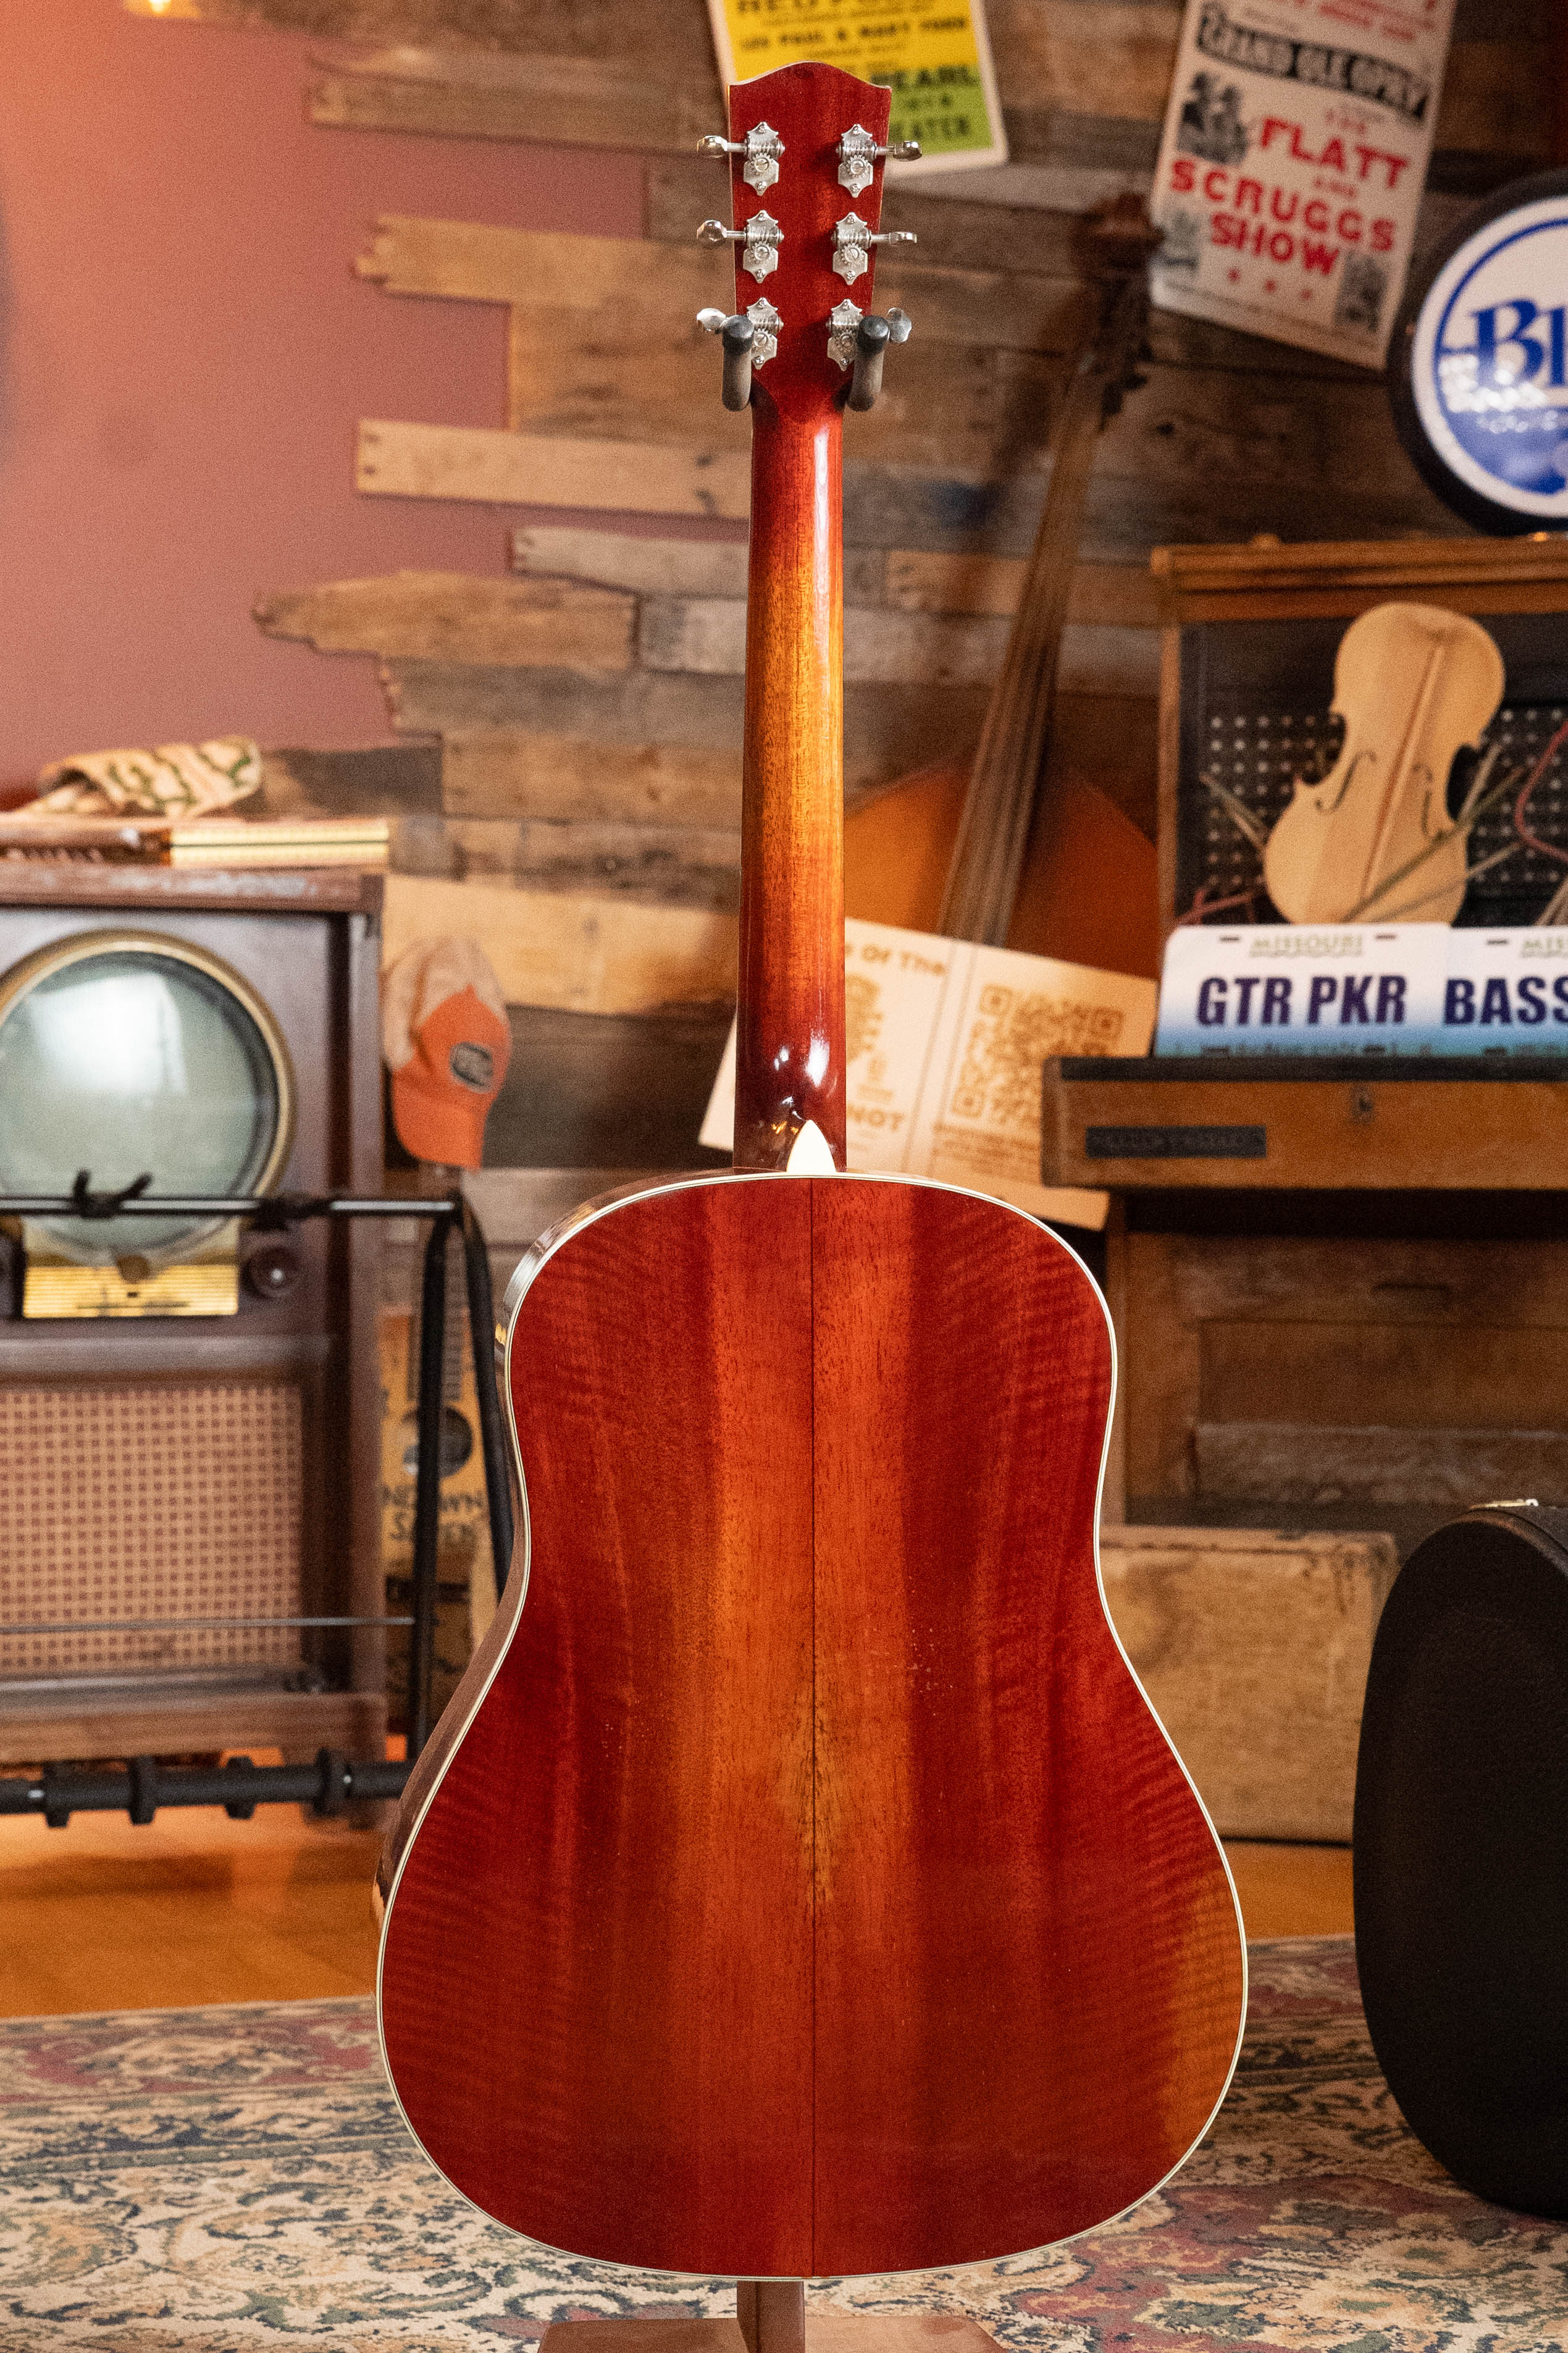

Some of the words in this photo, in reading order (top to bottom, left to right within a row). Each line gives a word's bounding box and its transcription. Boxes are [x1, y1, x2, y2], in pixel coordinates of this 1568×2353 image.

[1260, 116, 1411, 188] FLATT
[1170, 159, 1396, 252] SCRUGGS
[1210, 212, 1340, 276] SHOW
[1196, 976, 1293, 1026] GTR
[1306, 974, 1409, 1025] PKR
[1443, 976, 1568, 1026] BASS
